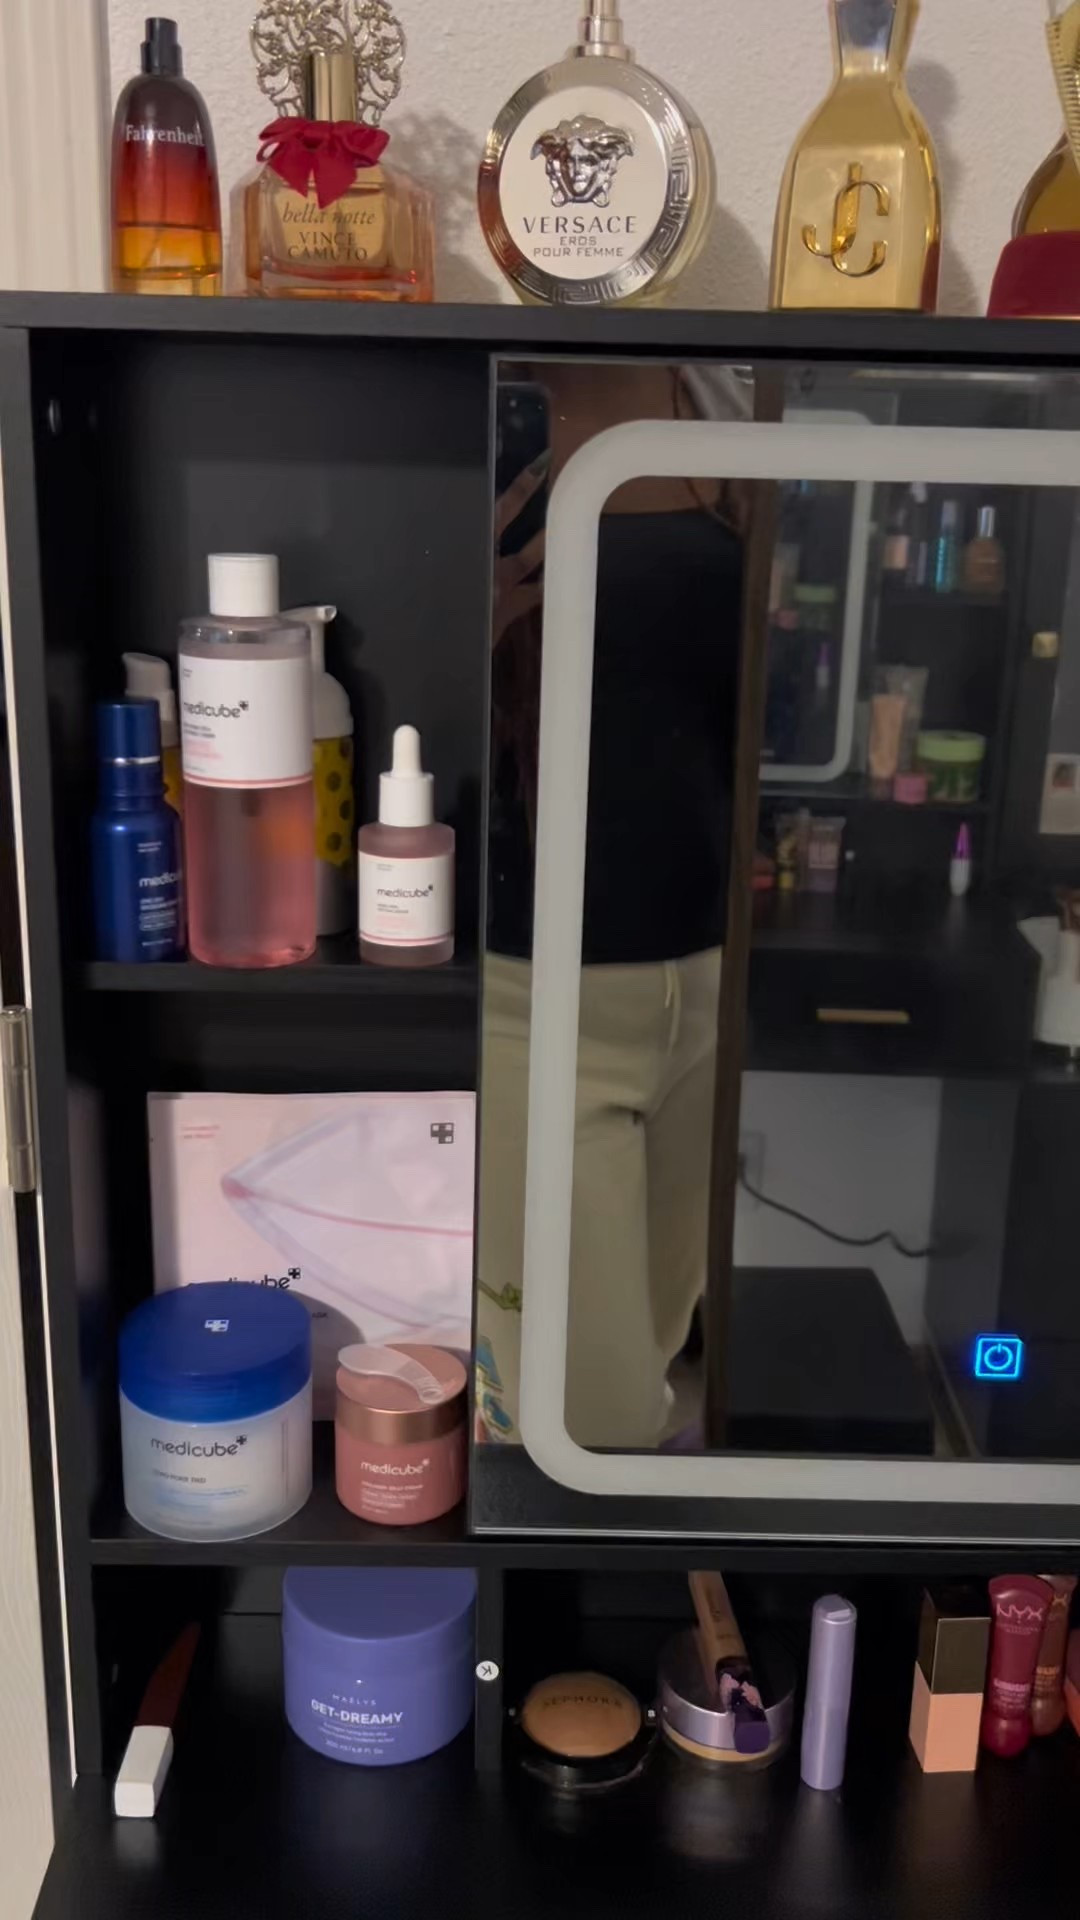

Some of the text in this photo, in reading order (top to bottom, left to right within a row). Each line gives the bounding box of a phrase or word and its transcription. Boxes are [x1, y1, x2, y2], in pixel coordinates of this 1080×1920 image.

[126, 123, 205, 146] Fahrenheit
[282, 201, 376, 225] bella notte
[522, 215, 638, 234] VERSACE
[299, 231, 356, 246] VINCE
[559, 235, 598, 246] EROS
[287, 245, 368, 261] CAMUTO
[533, 247, 624, 257] POUR FEMME
[376, 887, 430, 898] medicube
[150, 1437, 239, 1457] medicube
[360, 1461, 424, 1476] medicube
[996, 1603, 1044, 1624] NYX
[310, 1698, 404, 1725] GET-DREAMY
